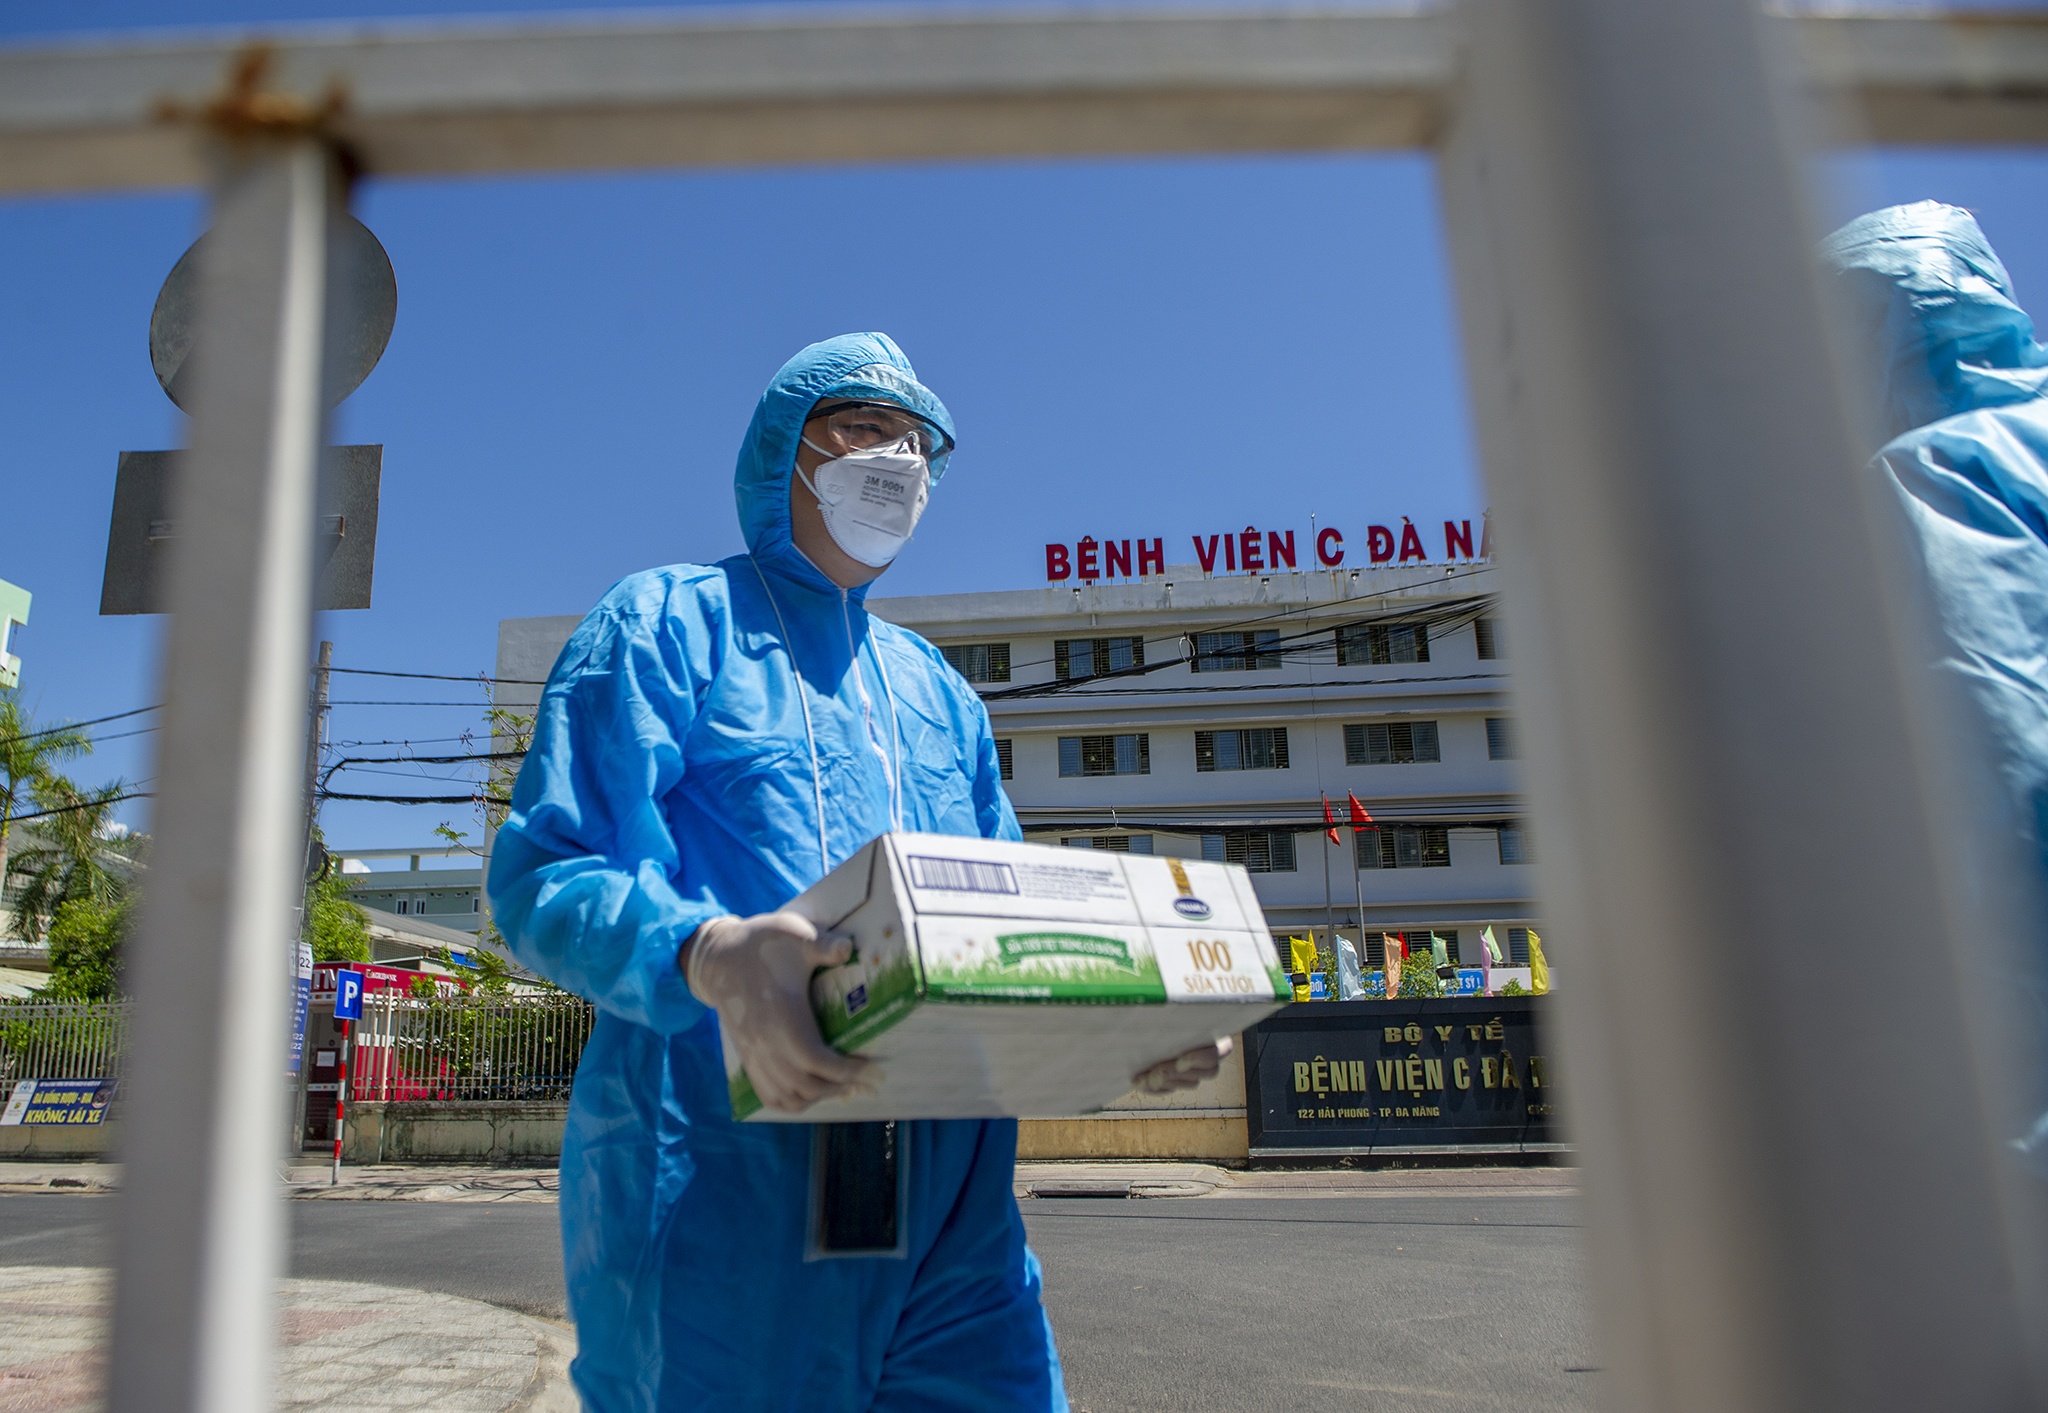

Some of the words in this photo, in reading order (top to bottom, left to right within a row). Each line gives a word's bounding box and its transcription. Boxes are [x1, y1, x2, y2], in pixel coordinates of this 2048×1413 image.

[864, 475, 880, 486] 3M
[881, 480, 904, 494] 9001
[1045, 535, 1165, 586] BỆNH
[1192, 526, 1297, 577] VIỆN
[1316, 527, 1345, 567] C
[1367, 516, 1427, 565] ĐÀ
[344, 980, 358, 1008] P
[1384, 1022, 1422, 1046] BỘ
[1434, 1025, 1453, 1041] Y
[1466, 1016, 1504, 1041] TẾ
[1293, 1055, 1366, 1099] BỆNH
[1375, 1053, 1444, 1098] VIỆN
[1453, 1057, 1470, 1090] C
[1481, 1050, 1521, 1089] ĐÀ
[24, 1107, 67, 1123] KHÔNG
[85, 1110, 102, 1123] XE
[1297, 1109, 1315, 1119] 122
